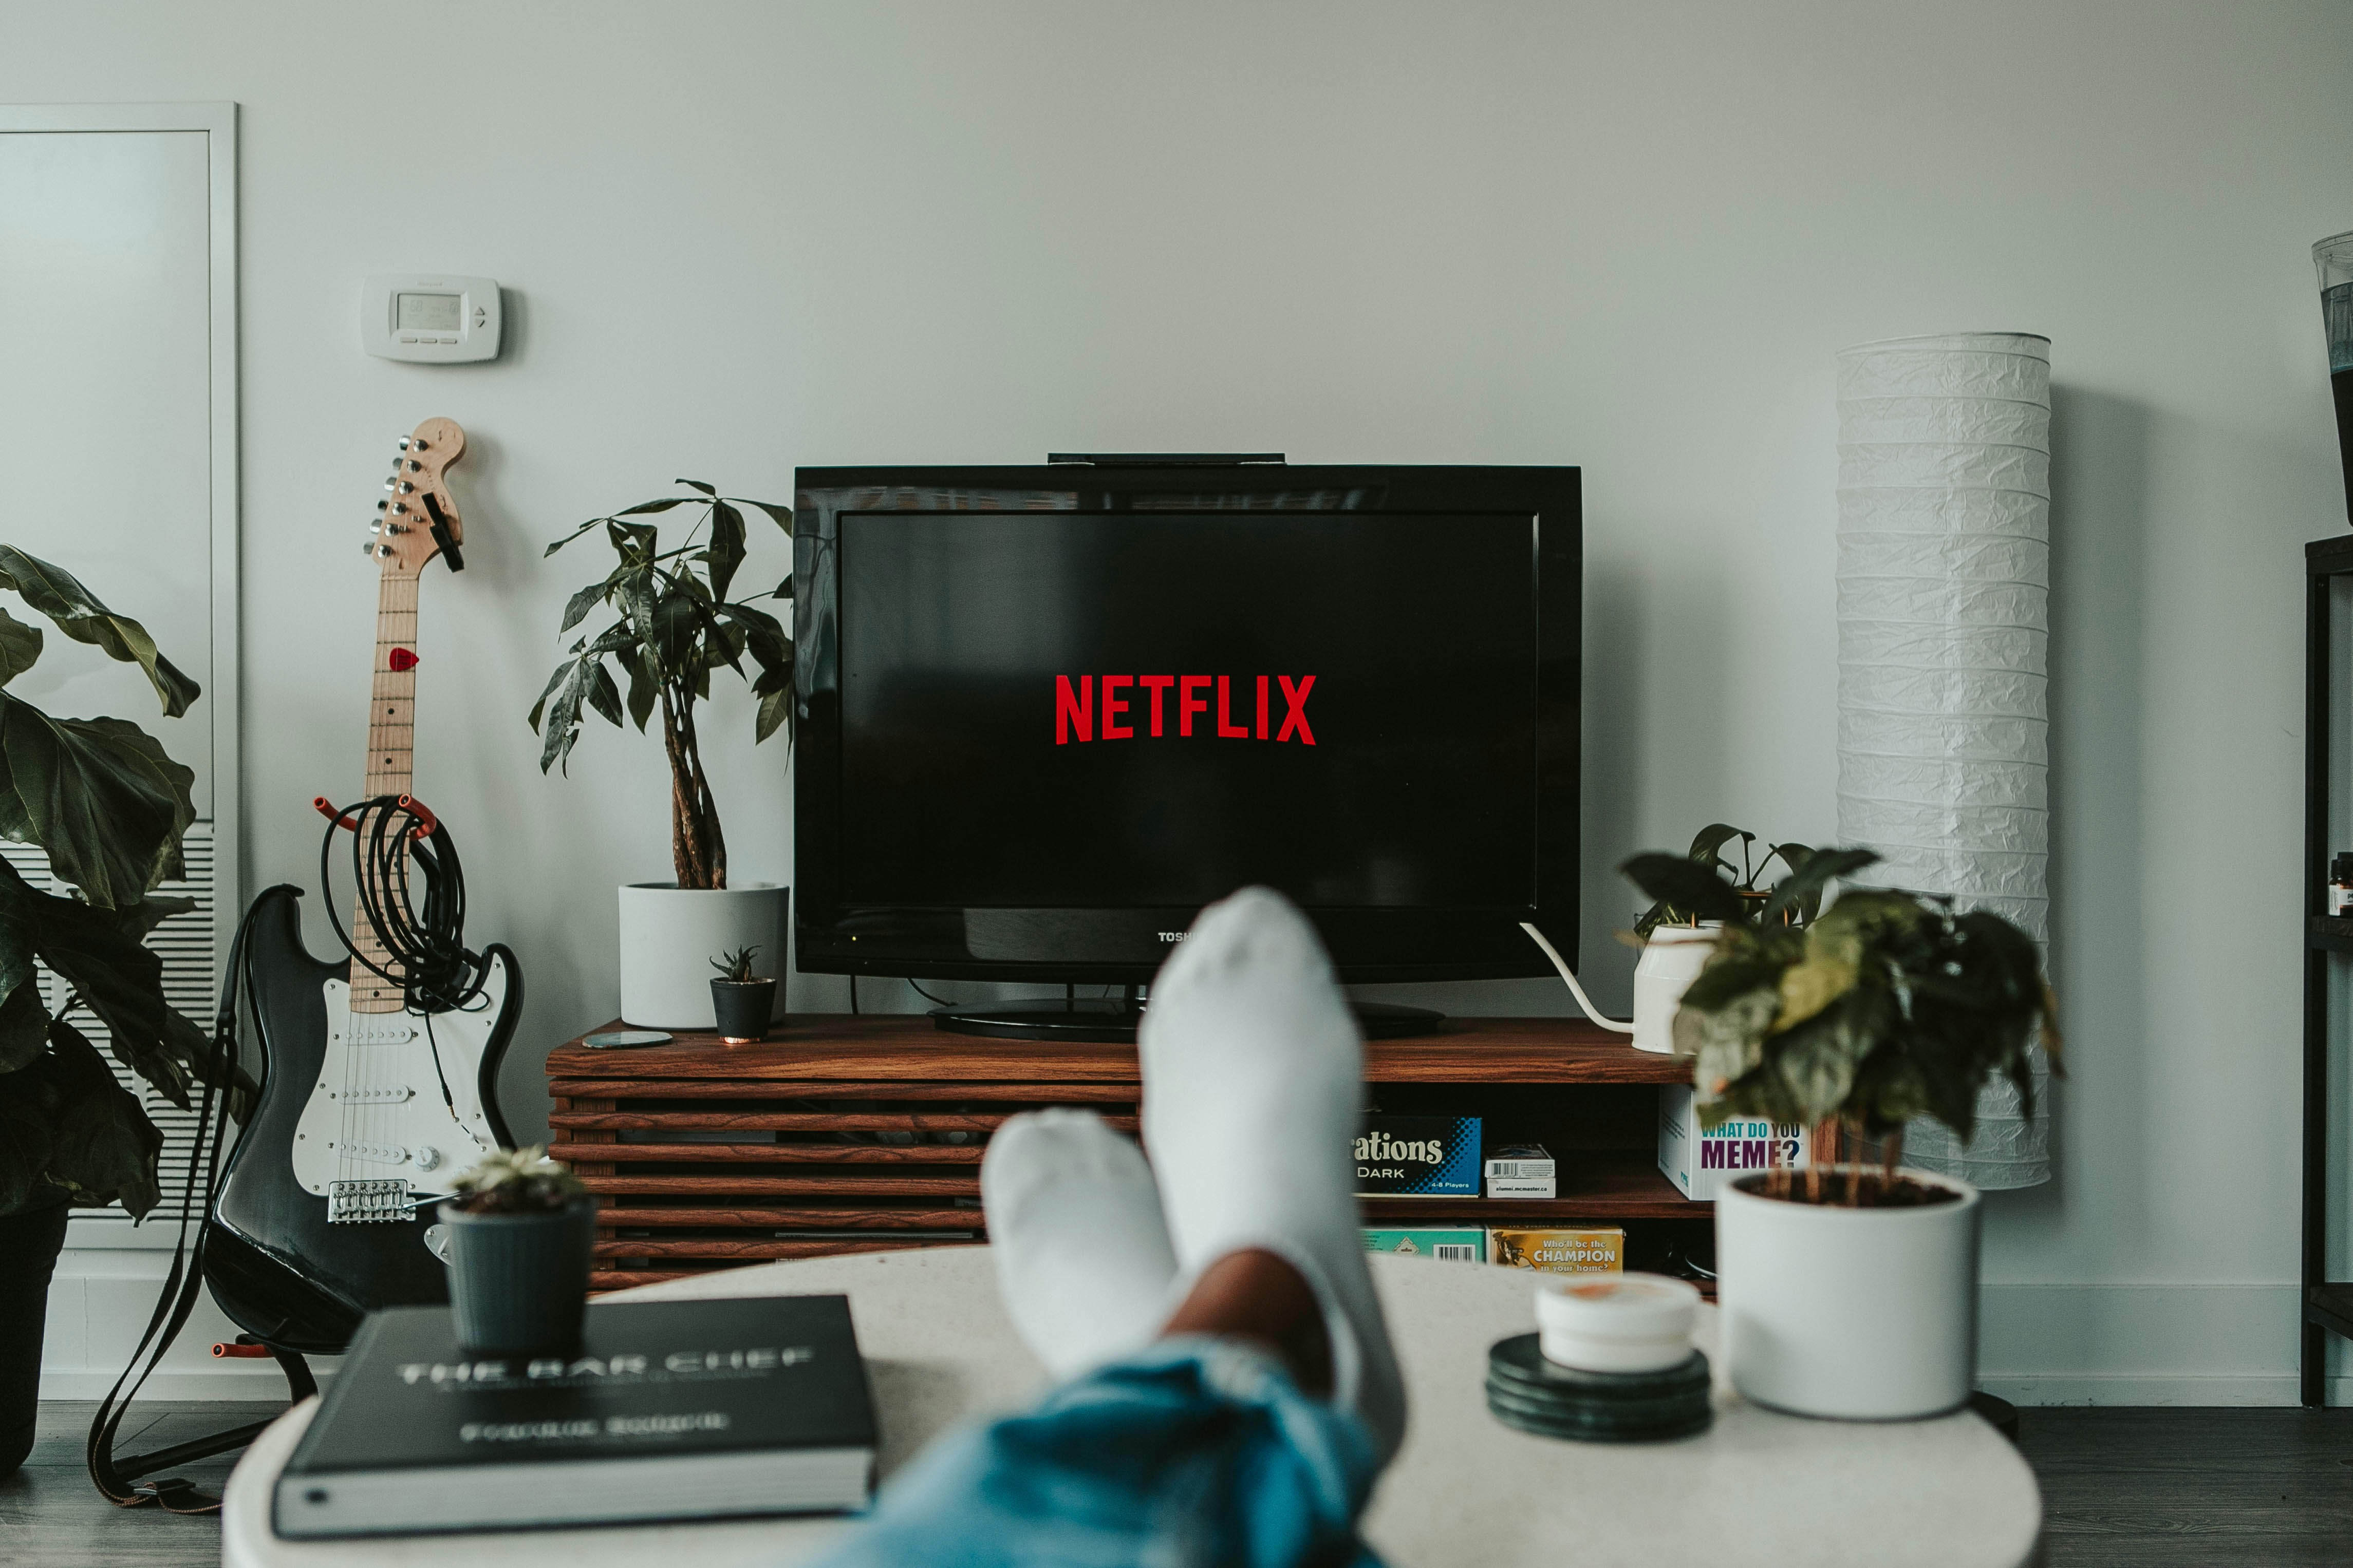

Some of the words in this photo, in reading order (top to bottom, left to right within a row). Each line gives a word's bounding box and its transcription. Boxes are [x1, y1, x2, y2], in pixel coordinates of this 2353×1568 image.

[1056, 675, 1316, 746] NETFLIX
[1158, 932, 1193, 942] TOSH
[1702, 1123, 1744, 1137] WHAT
[1748, 1123, 1767, 1138] DO
[1771, 1122, 1800, 1138] YOU
[1351, 1131, 1443, 1164] ations
[1701, 1140, 1800, 1169] MEME?
[1357, 1167, 1405, 1178] DARK
[1576, 1239, 1588, 1249] be
[1591, 1240, 1606, 1249] the
[1533, 1250, 1615, 1262] CHAMPION
[1577, 1264, 1608, 1273] home?
[396, 1360, 509, 1385] THE
[664, 1345, 815, 1373] CHEF
